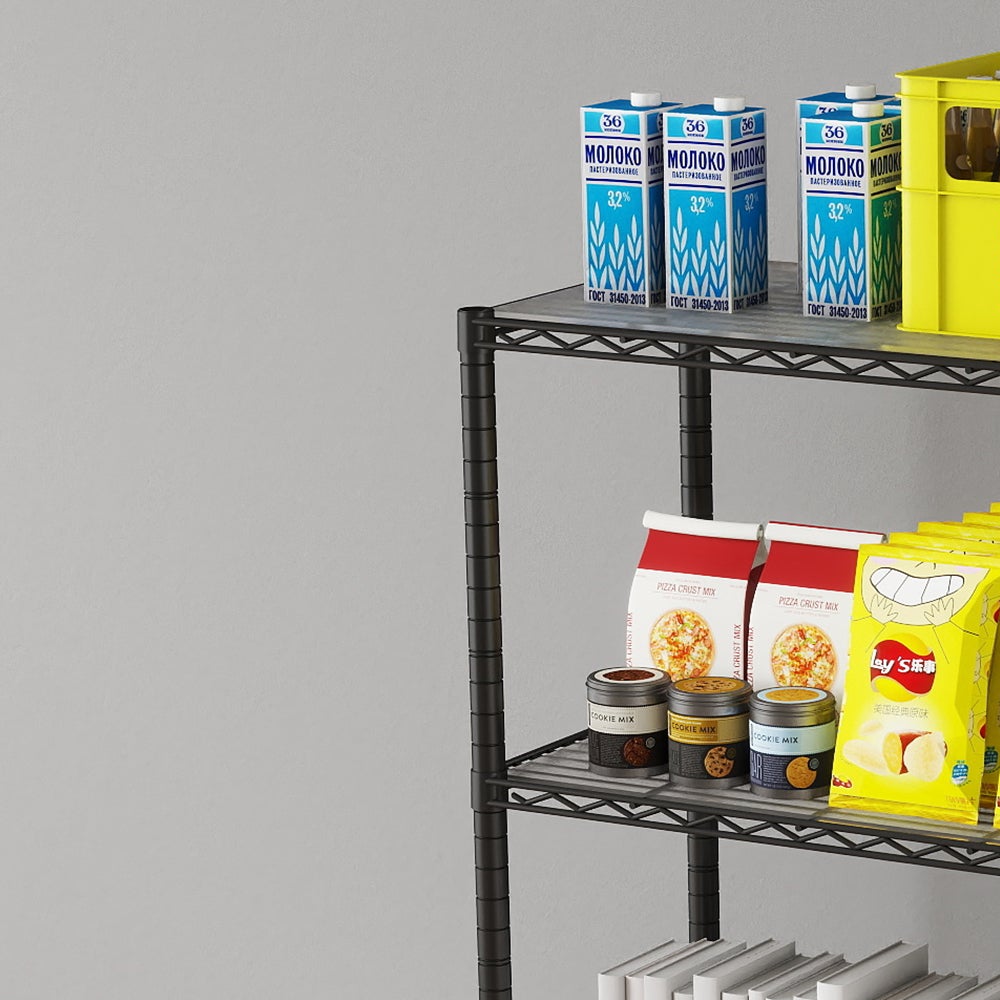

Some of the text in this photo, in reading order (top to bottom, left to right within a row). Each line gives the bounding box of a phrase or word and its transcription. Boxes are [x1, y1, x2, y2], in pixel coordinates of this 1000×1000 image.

[603, 114, 622, 128] 36
[686, 119, 705, 133] 36
[742, 116, 754, 131] 36
[825, 125, 844, 139] 36
[881, 123, 893, 137] 36
[585, 144, 642, 166] МОЛОКО
[667, 149, 725, 171] МОЛОКО
[731, 145, 766, 172] МОЛОКО
[806, 156, 865, 178] МОЛОКО
[588, 289, 646, 305] ГОСТ 31450-2013
[670, 296, 687, 309] ГОСТ
[691, 299, 729, 312] 31450-2013
[807, 303, 826, 316] ГОСТ
[829, 305, 868, 319] 31450-2013
[657, 582, 716, 596] PIZZA CRUST MIX
[779, 596, 839, 611] PIZZA CRUST MIX
[733, 624, 741, 640] MIX
[733, 641, 741, 668] CRUST
[591, 711, 635, 723] COOKIE MIX
[671, 722, 697, 733] COOKIE
[753, 732, 799, 744] COOKIE MIX
